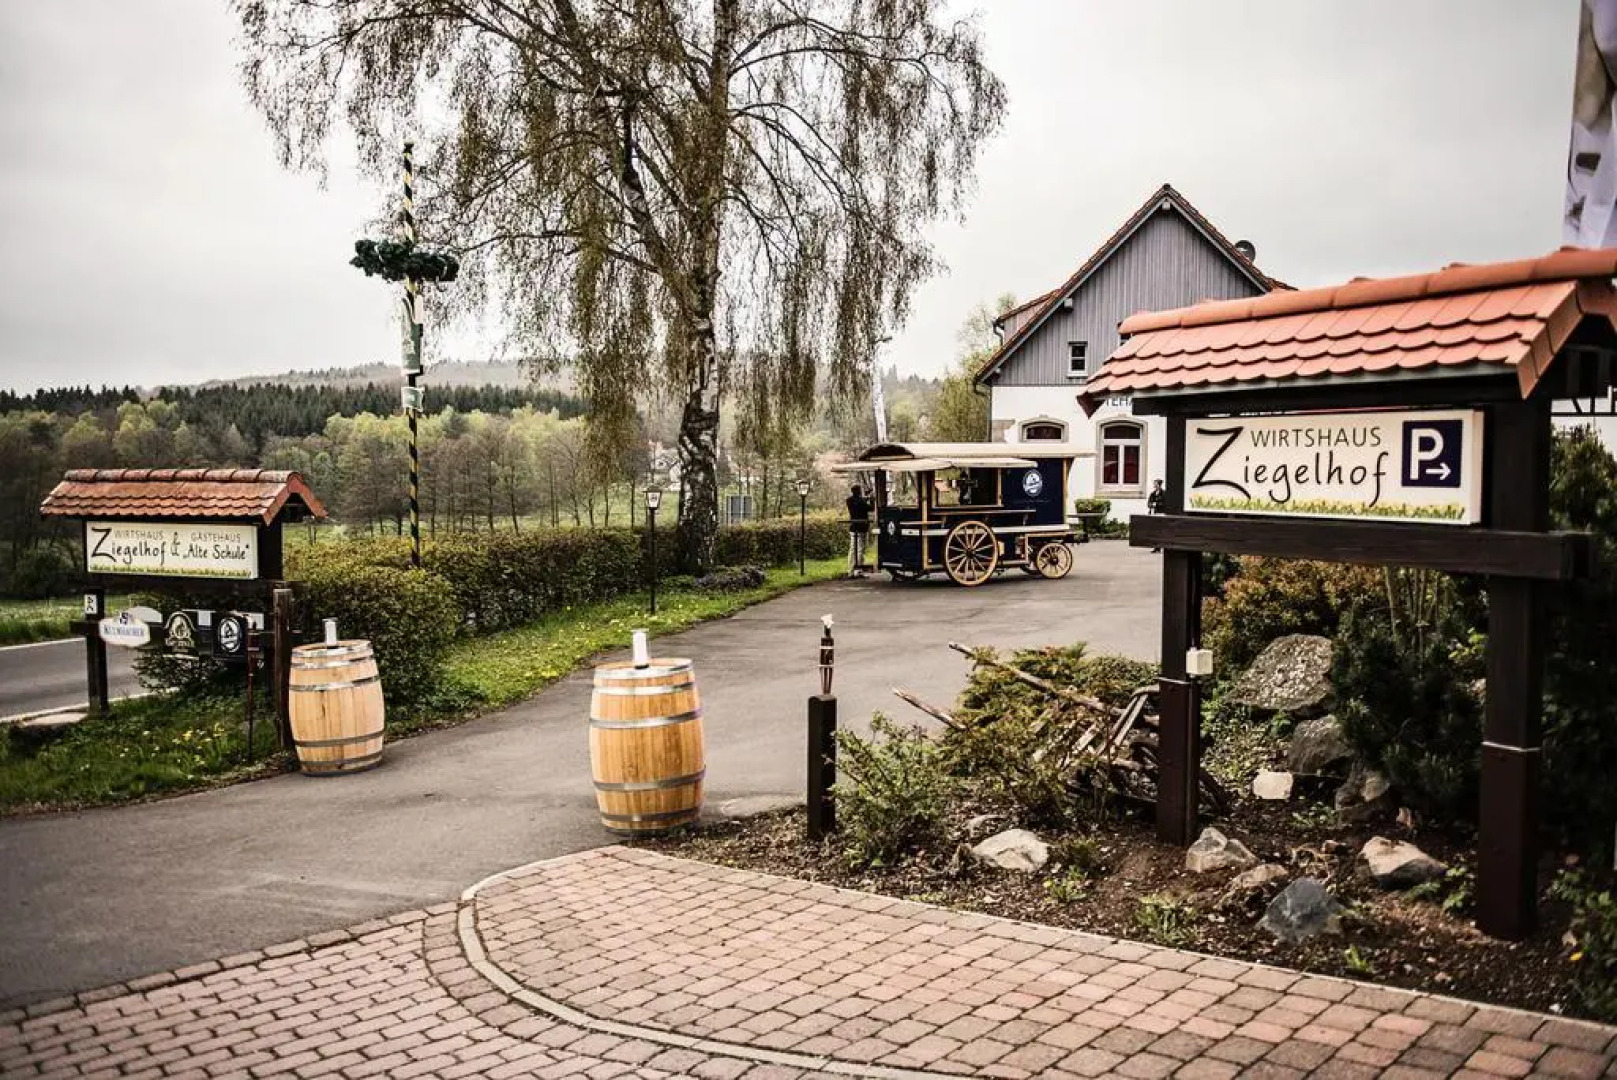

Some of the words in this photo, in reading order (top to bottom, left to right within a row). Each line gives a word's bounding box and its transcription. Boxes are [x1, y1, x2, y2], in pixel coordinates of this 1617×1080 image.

[1250, 426, 1382, 448] WIRTSHAUS
[1409, 427, 1445, 480] P
[1191, 426, 1389, 507] Ziegelhof
[91, 527, 166, 566] Ziegelhof
[114, 530, 164, 541] WIRTSHAUS
